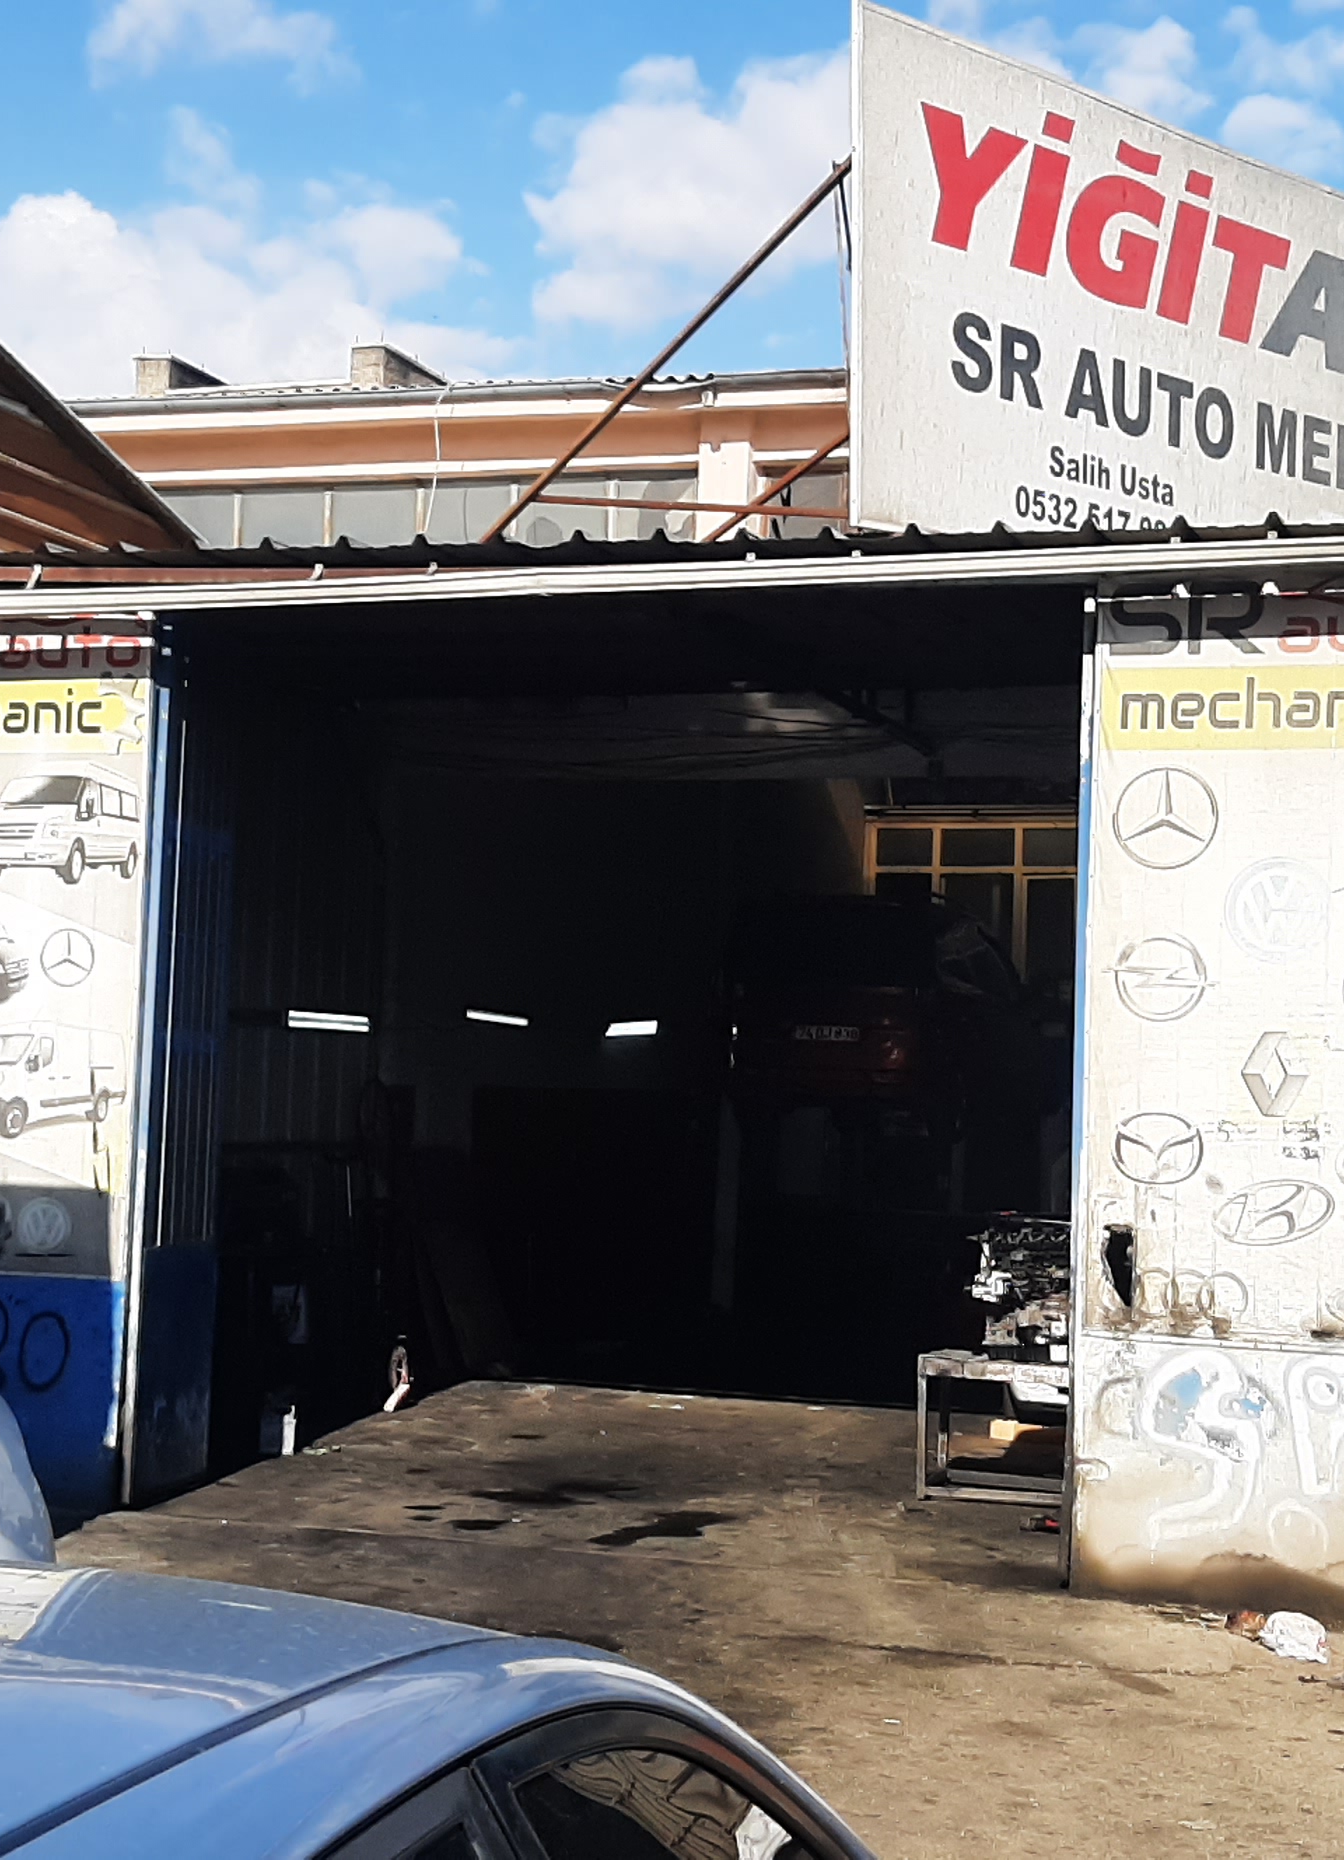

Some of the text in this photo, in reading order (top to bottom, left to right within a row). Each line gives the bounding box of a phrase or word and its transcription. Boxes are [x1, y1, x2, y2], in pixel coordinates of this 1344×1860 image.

[951, 311, 1043, 409] SR
[1064, 348, 1234, 459] AUTO
[1016, 485, 1077, 529] 0532
[1049, 446, 1174, 507] Salih Usta
[1109, 581, 1266, 656] SR
